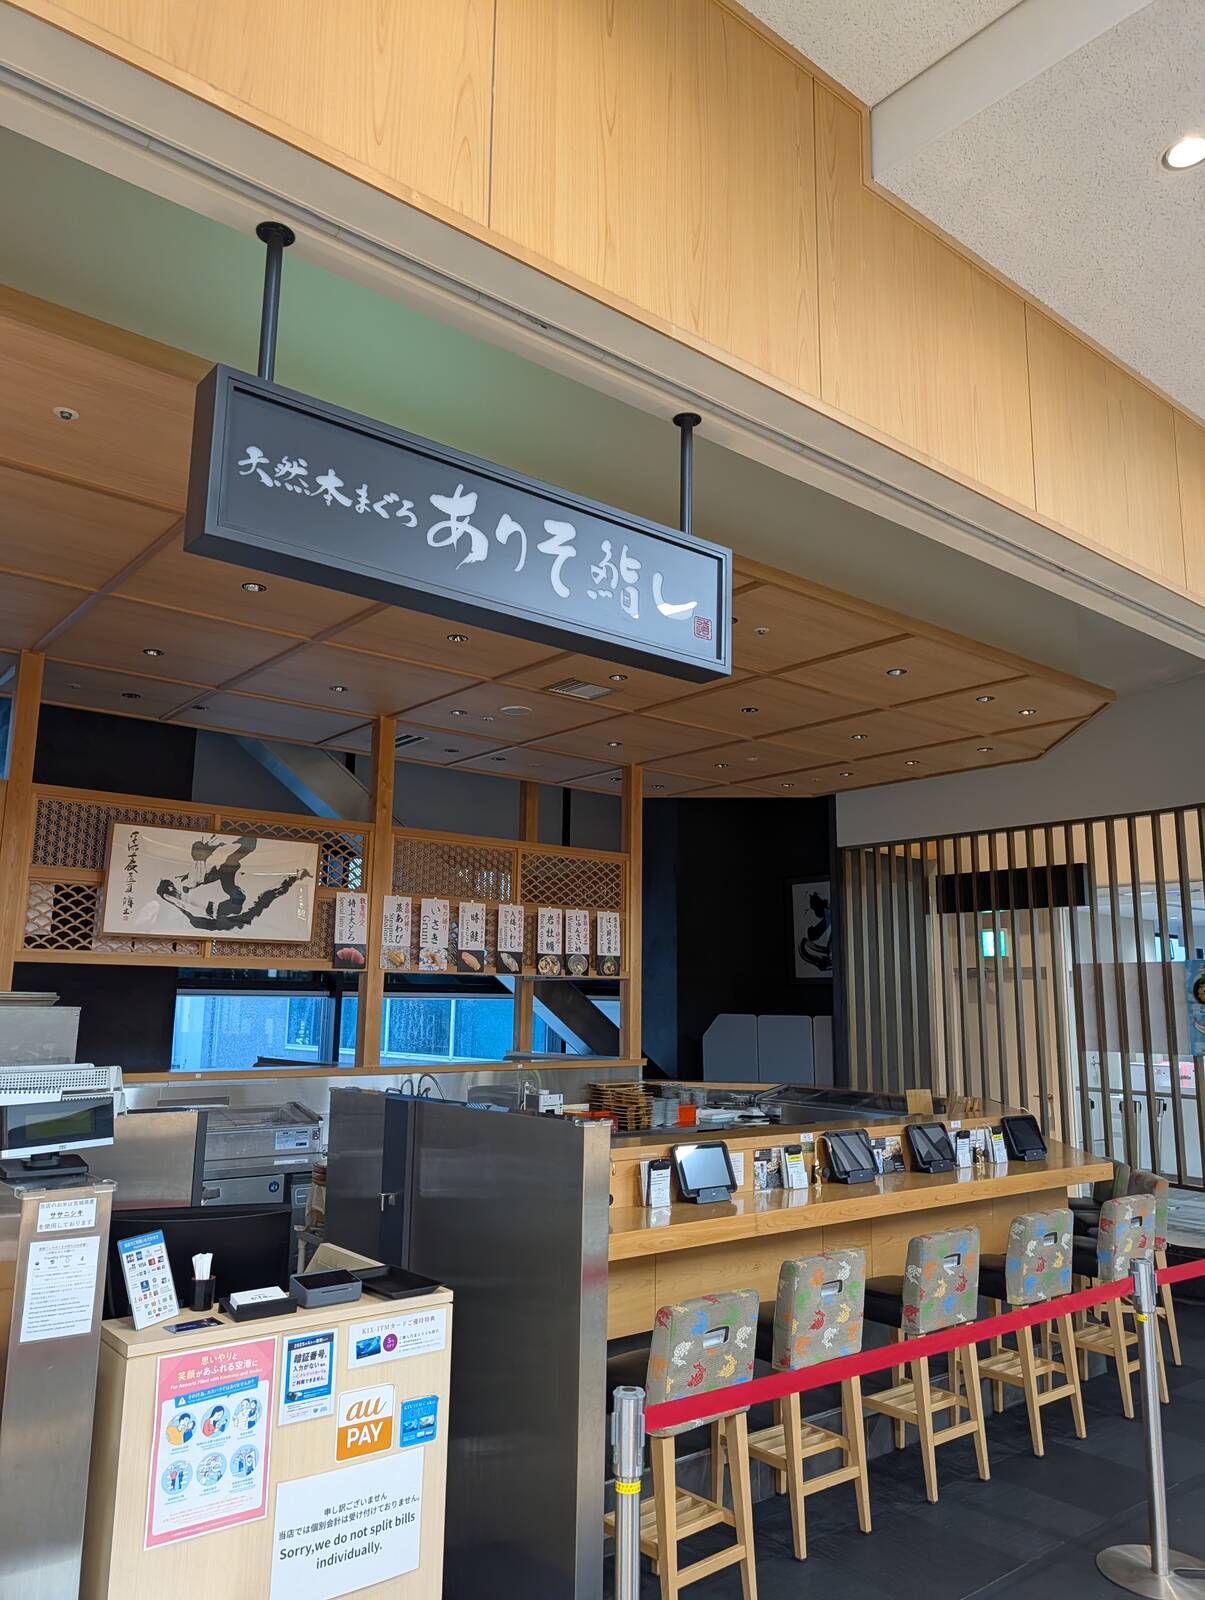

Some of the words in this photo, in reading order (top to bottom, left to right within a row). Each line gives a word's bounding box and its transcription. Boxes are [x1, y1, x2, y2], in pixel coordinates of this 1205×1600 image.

[237, 446, 418, 527] 天然本まぐろ
[426, 484, 698, 620] ありそ鮨し
[348, 898, 356, 941] 特上大とろ
[422, 915, 430, 944] Grunt
[431, 906, 440, 945] いさき
[546, 914, 555, 952] 岩牡蠣
[50, 1210, 83, 1218] ササニシキ
[177, 1360, 258, 1382] 笑顔があふれる空港に
[201, 1352, 238, 1366] 思いやりと
[346, 1397, 387, 1421] au
[346, 1421, 384, 1449] PAY
[278, 1494, 420, 1540] 当店では個別会計は受け付けておりません。
[324, 1492, 387, 1516] 申し訳ございません
[279, 1539, 331, 1560] Sorry,we
[333, 1533, 348, 1547] do
[349, 1526, 368, 1541] not
[370, 1519, 393, 1536] split
[394, 1511, 416, 1527] bills
[315, 1541, 383, 1570] individually.
